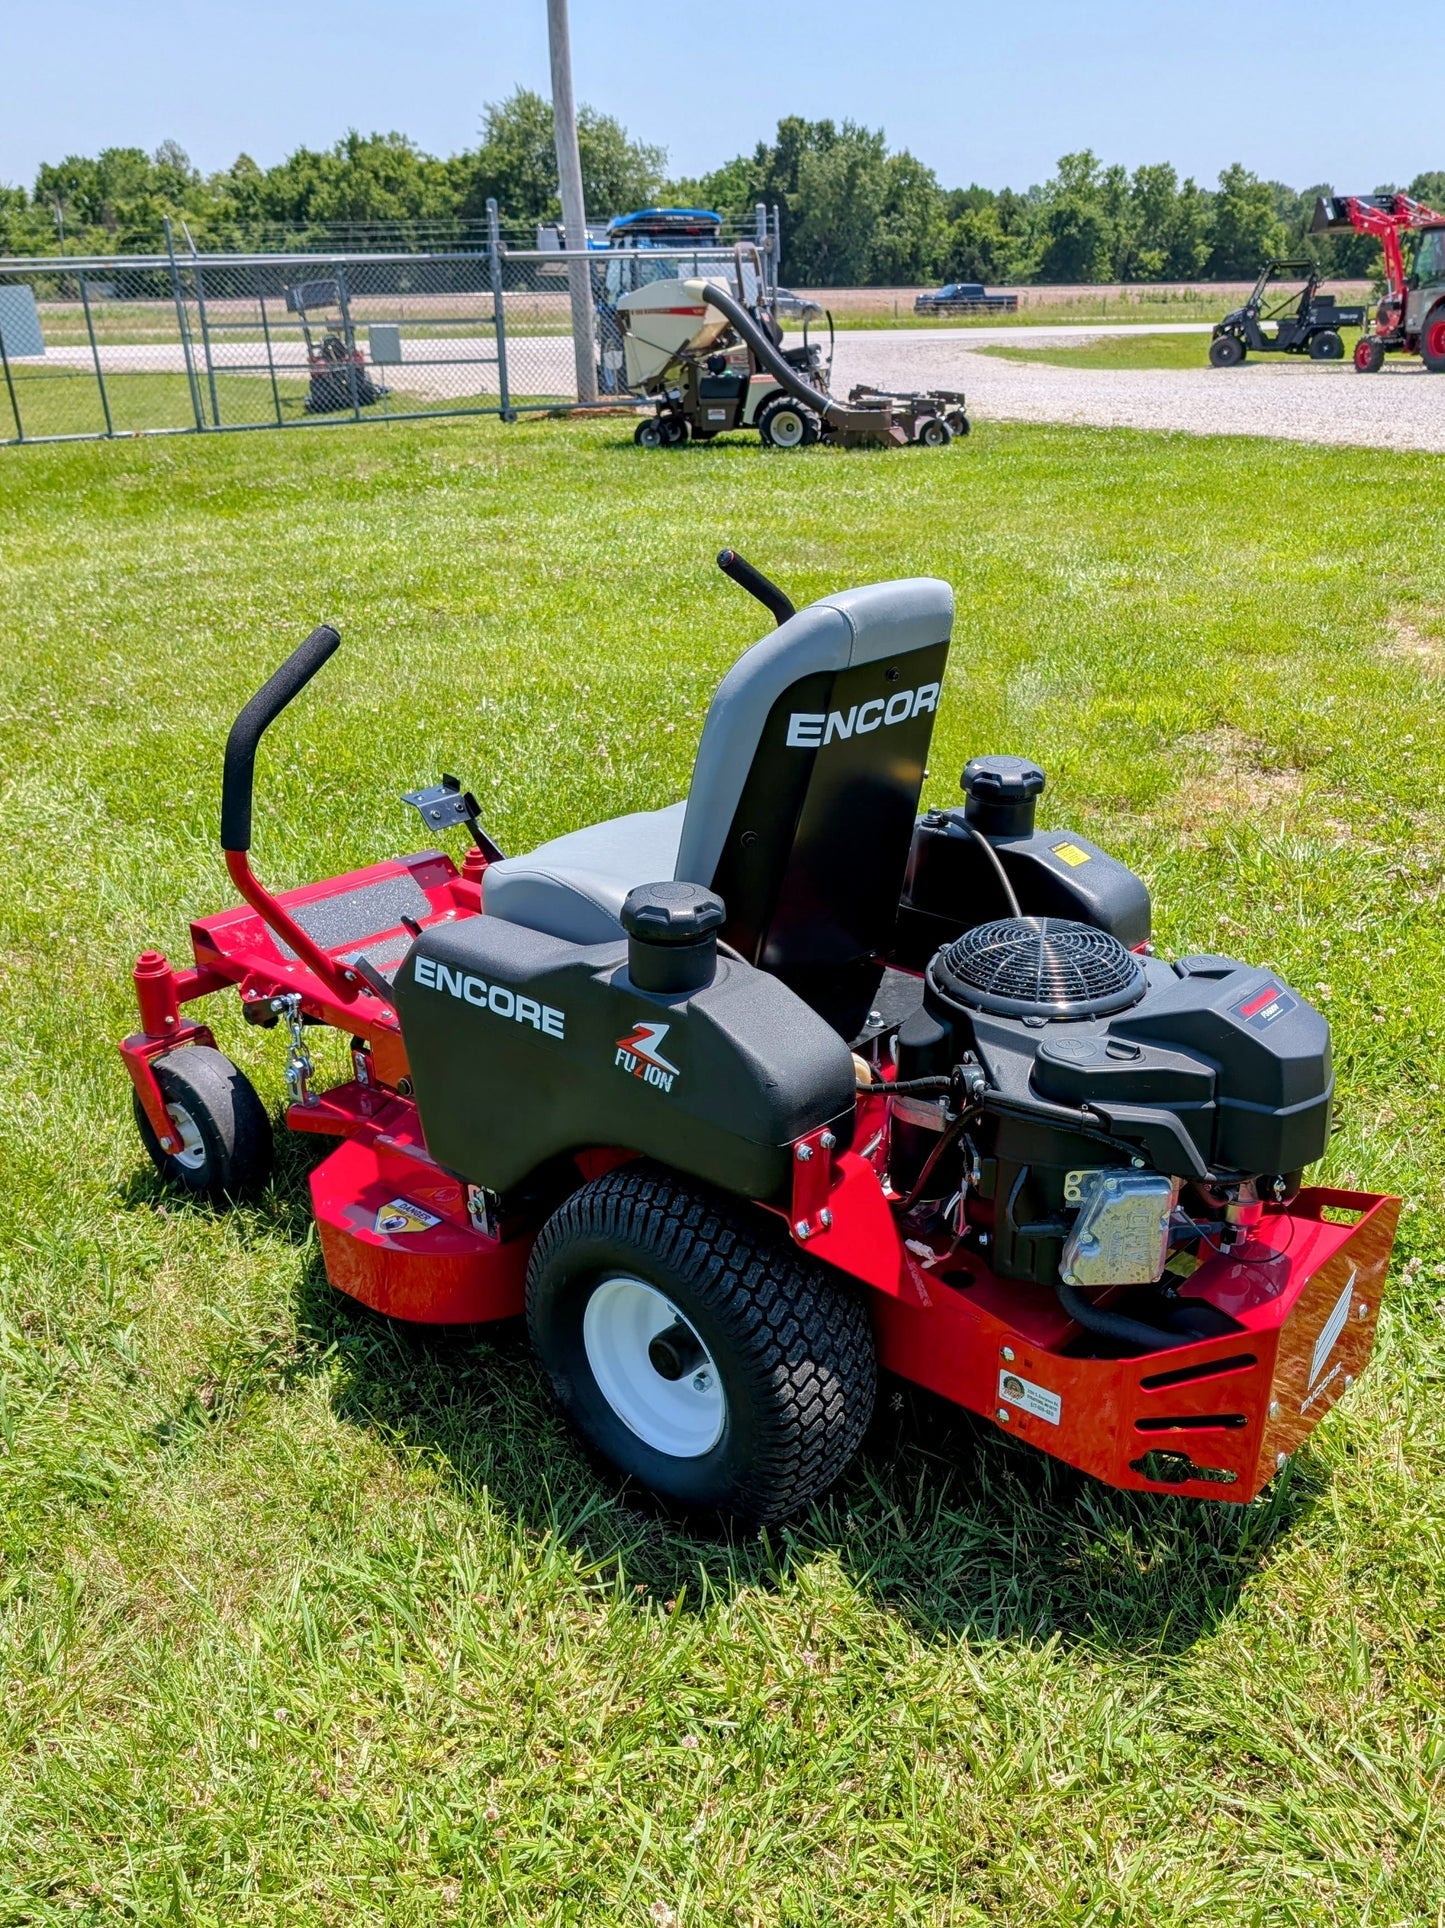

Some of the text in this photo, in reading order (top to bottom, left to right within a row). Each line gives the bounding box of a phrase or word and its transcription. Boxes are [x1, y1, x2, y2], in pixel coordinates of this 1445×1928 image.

[786, 682, 940, 747] ENCOR
[414, 955, 565, 1040] ENCORE
[614, 1047, 674, 1093] FUZION
[398, 1203, 432, 1221] DANGER
[1300, 1361, 1342, 1415] ENCORE
